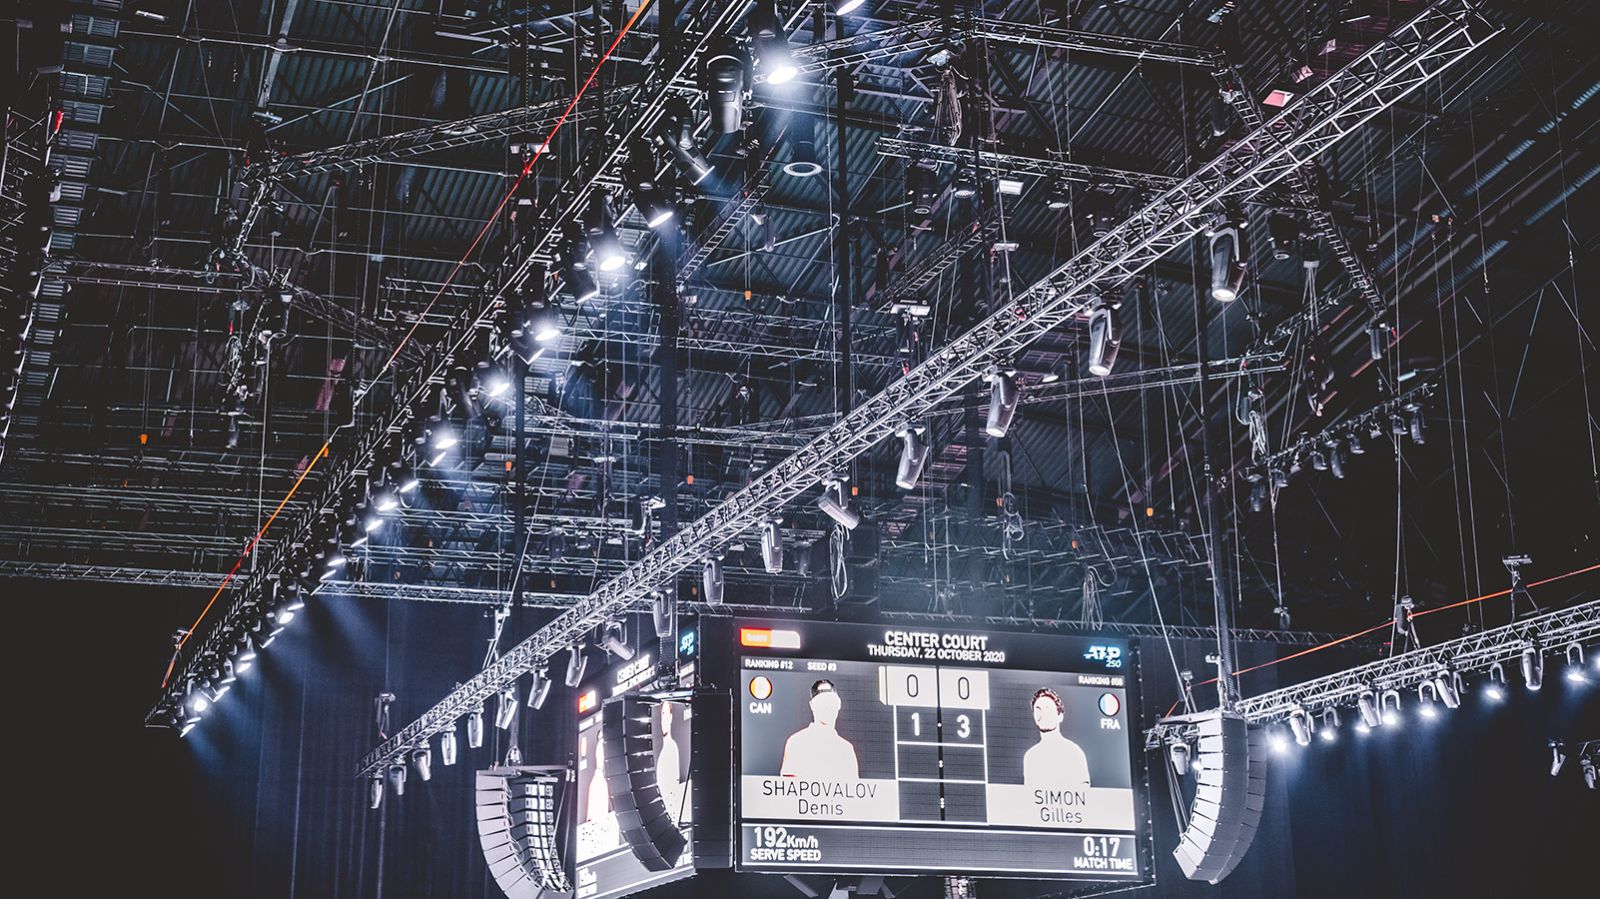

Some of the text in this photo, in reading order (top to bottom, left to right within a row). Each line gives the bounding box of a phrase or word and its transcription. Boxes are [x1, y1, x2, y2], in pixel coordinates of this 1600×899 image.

[885, 630, 988, 650] CENTER COURT
[867, 644, 1005, 662] THURSDAY, 22 OCTOBER 2020
[745, 658, 779, 669] RANKING
[807, 661, 827, 671] SEED
[906, 674, 970, 700] 0 0
[749, 702, 772, 714] CAN
[911, 712, 970, 738] 1 3
[1100, 717, 1120, 730] FRA
[762, 780, 877, 798] SHAPOVALOV
[1034, 789, 1086, 806] SIMON
[798, 799, 844, 815] Denis
[1040, 807, 1083, 823] Gilles
[750, 848, 821, 861] SERVE SPEED
[1083, 836, 1121, 858] 0:17
[1073, 857, 1133, 870] MATCH TIME
